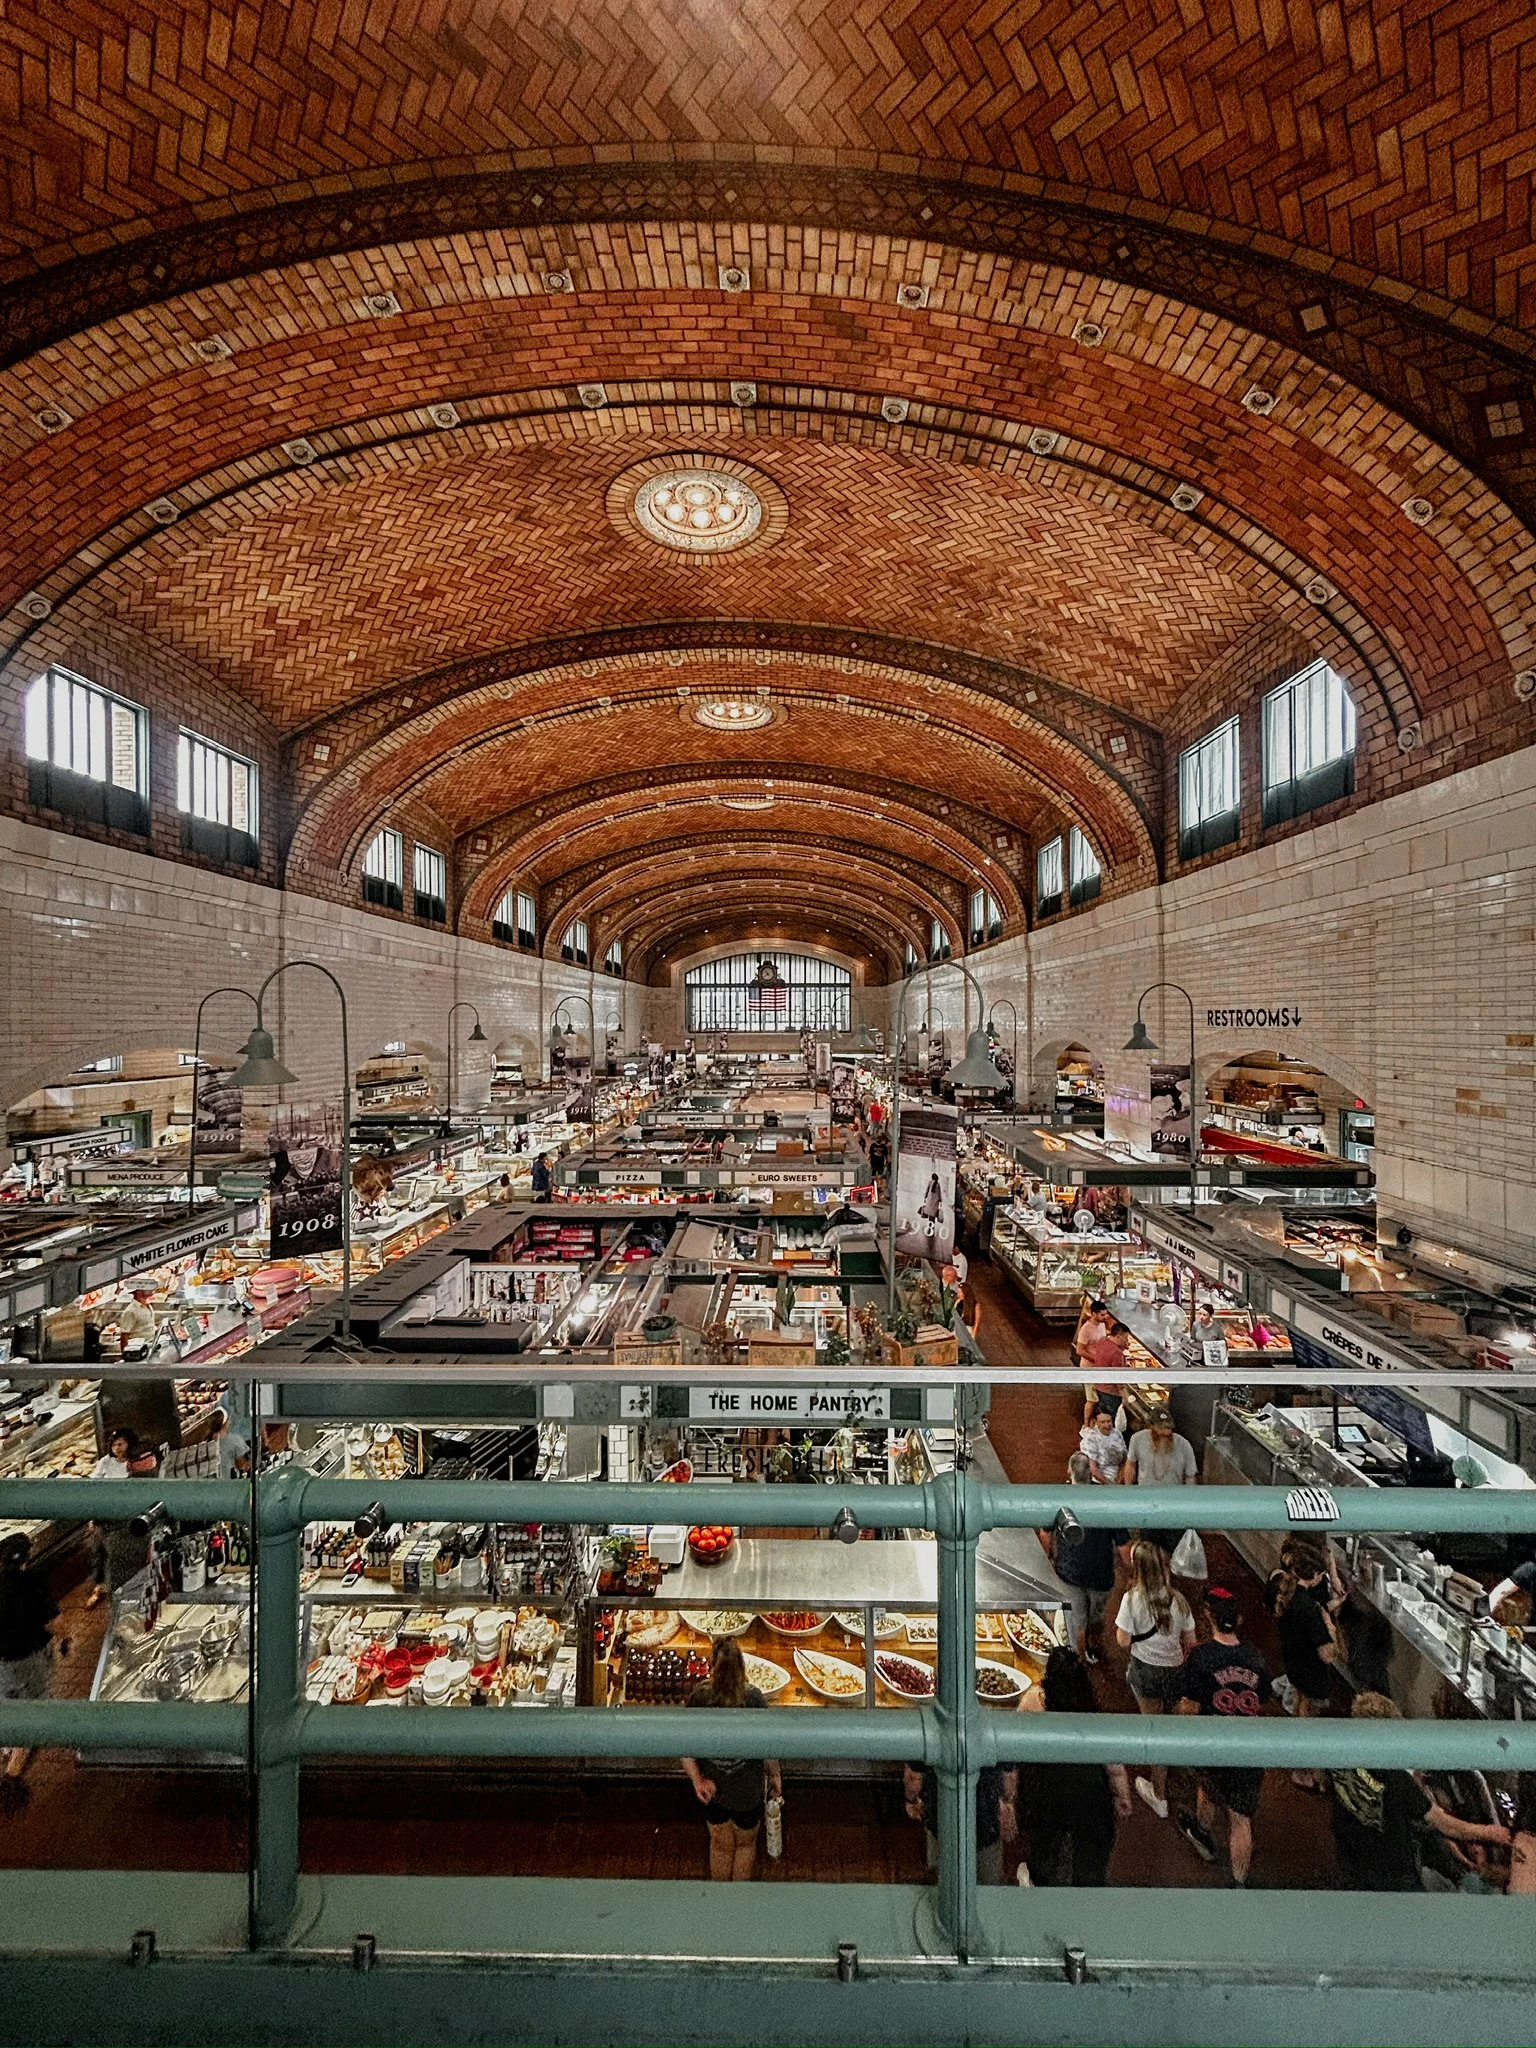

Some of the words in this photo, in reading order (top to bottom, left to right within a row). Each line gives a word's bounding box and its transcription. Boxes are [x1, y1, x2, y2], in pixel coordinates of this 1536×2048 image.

[1208, 1008, 1289, 1027] RESTROOMS
[570, 1106, 588, 1115] 1917
[1154, 1132, 1186, 1143] 1980
[278, 1213, 335, 1238] 1908
[900, 1218, 949, 1240] 1980
[130, 1245, 165, 1267] WHITE
[166, 1232, 204, 1254] FLOWER
[205, 1222, 229, 1239] CAKE
[1367, 1351, 1383, 1369] DE
[709, 1395, 740, 1410] THE
[751, 1395, 798, 1411] HOME
[809, 1396, 872, 1412] PANTRY
[704, 1447, 771, 1473] FRESH
